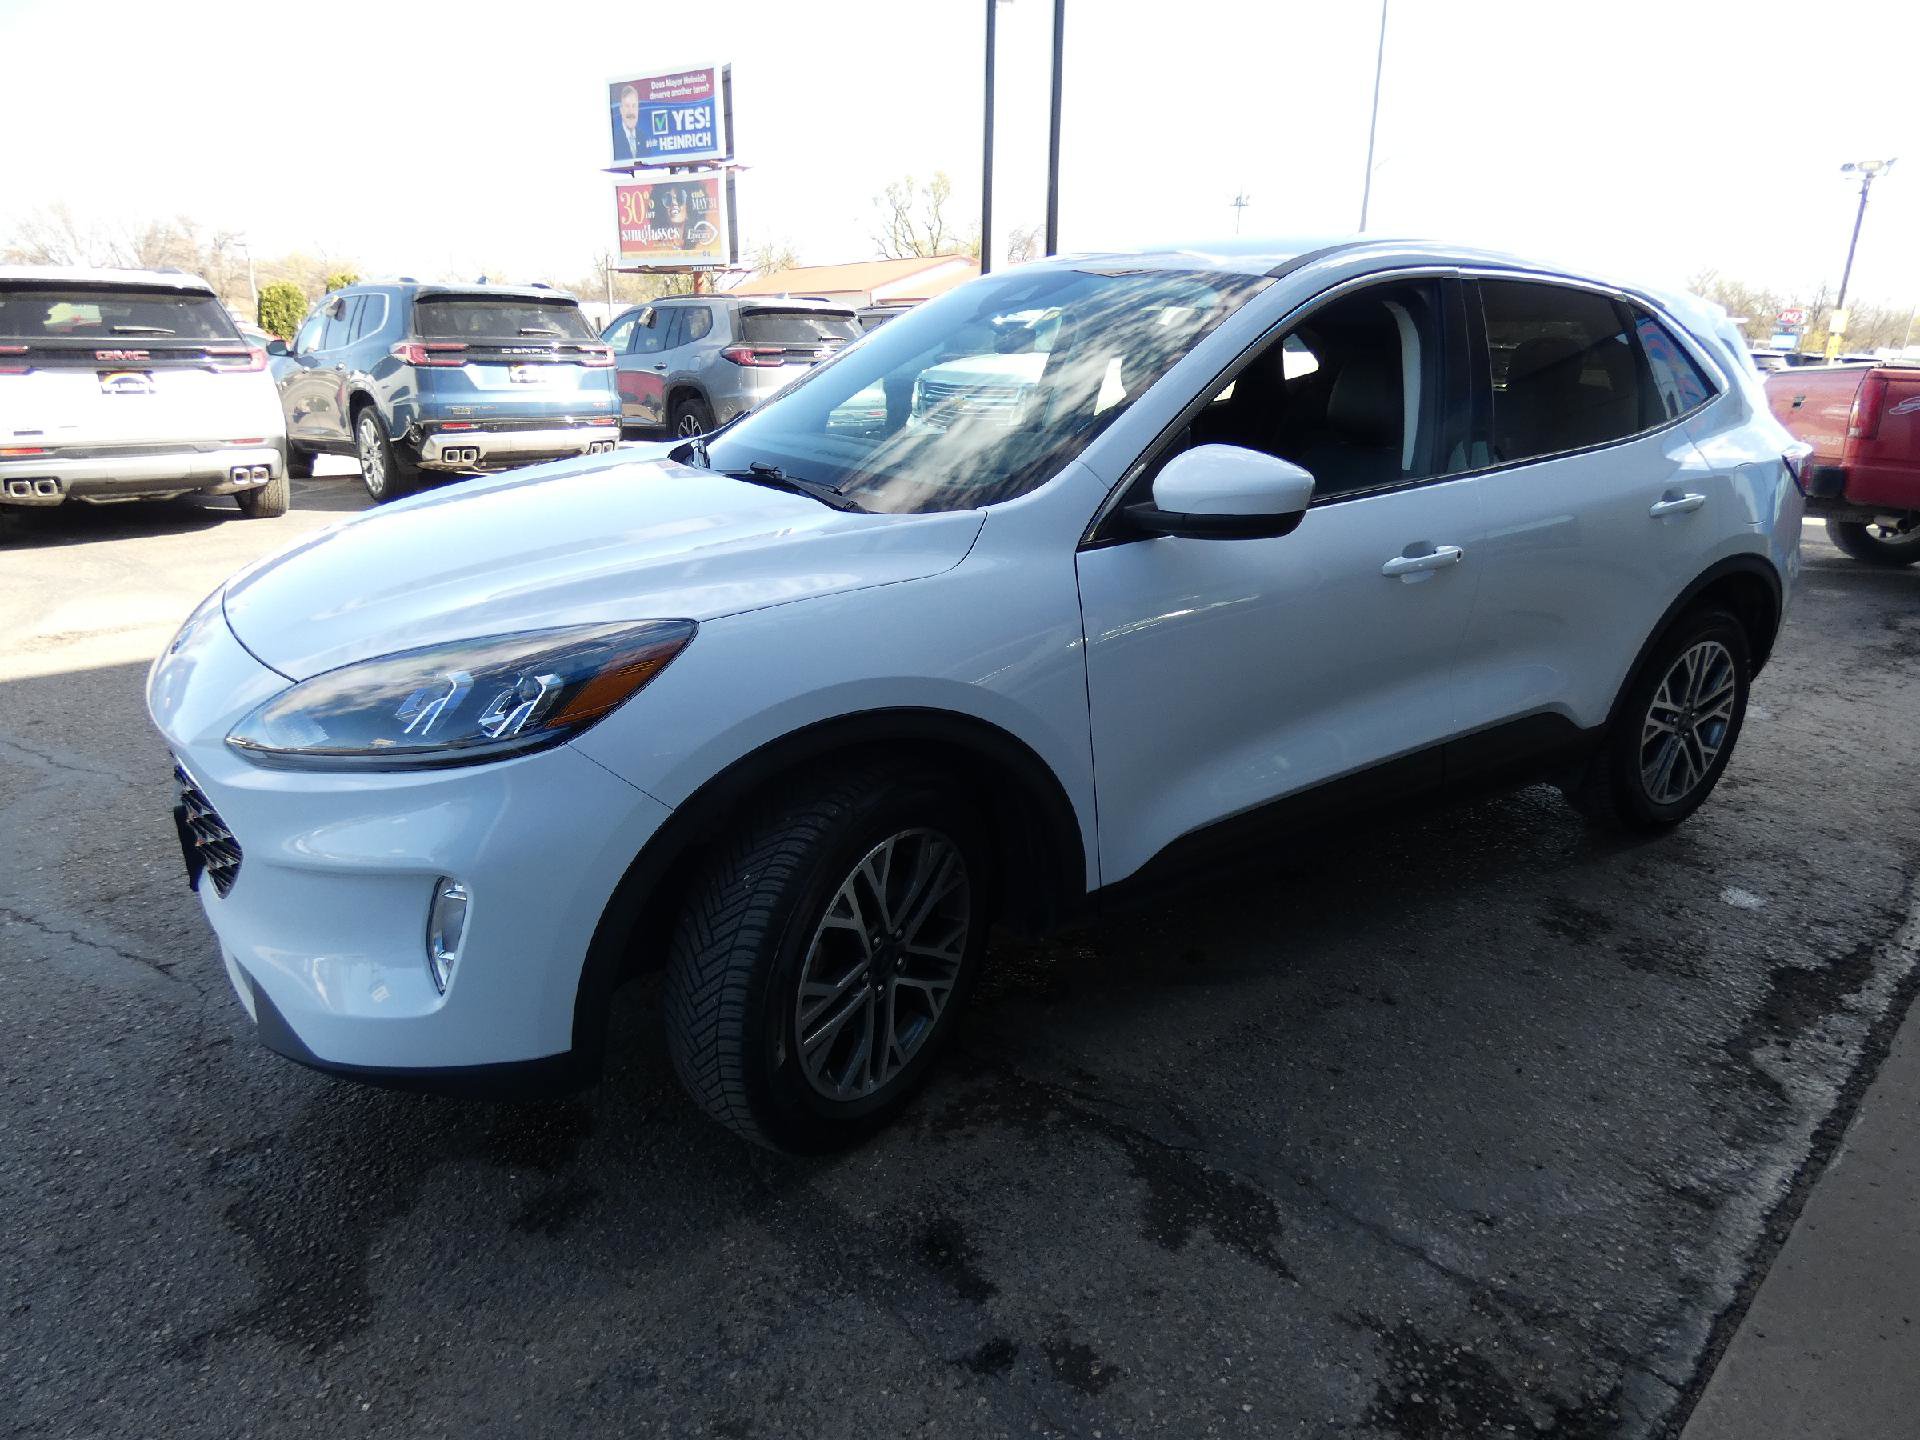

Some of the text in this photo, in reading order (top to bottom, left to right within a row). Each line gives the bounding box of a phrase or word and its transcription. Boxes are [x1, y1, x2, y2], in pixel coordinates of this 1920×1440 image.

[651, 74, 706, 90] Does Mayor Heinrich
[650, 83, 709, 100] deserve another term?
[672, 106, 710, 130] YES!
[659, 132, 711, 150] HEINRICH
[692, 197, 708, 210] MAY
[622, 224, 680, 245] sunglasses
[95, 350, 151, 361] GMC
[501, 347, 552, 355] DENAL
